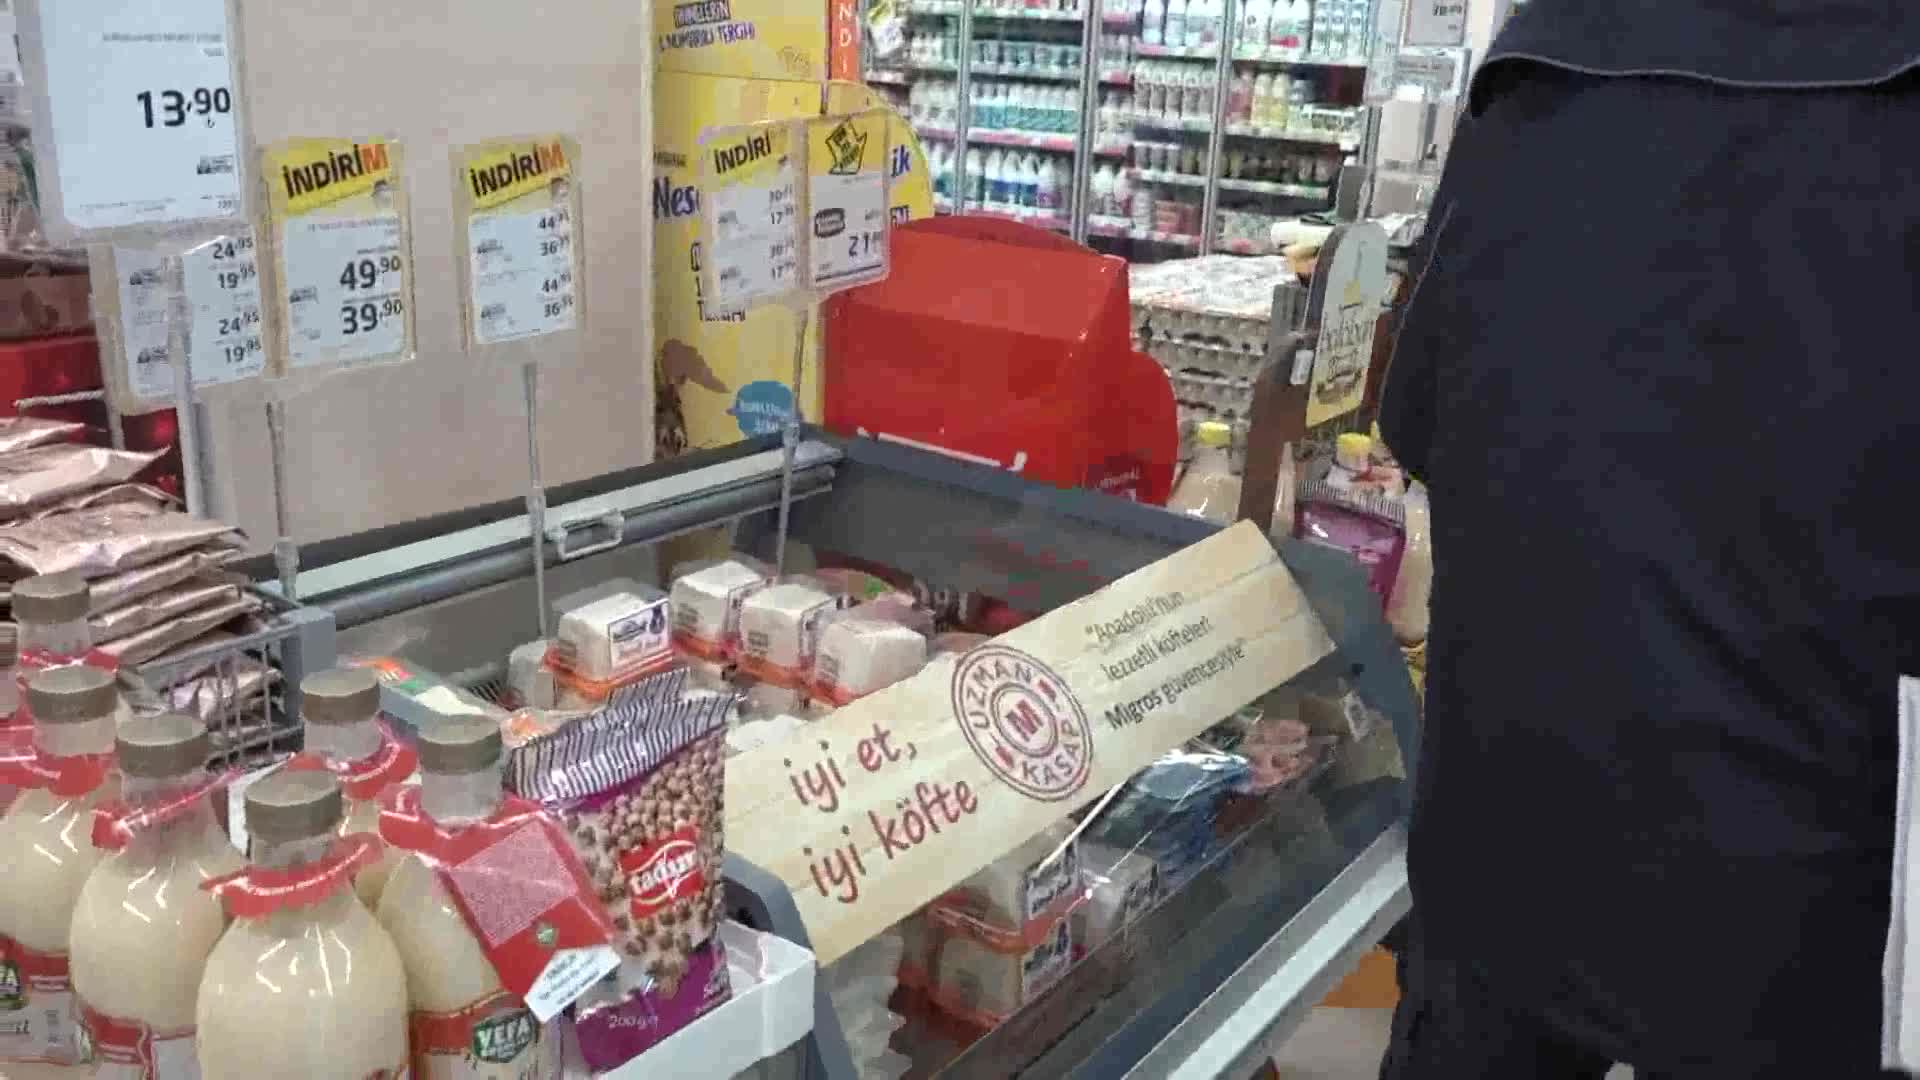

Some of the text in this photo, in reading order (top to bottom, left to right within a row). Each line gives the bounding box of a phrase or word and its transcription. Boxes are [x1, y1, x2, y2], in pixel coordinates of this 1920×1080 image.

[137, 87, 231, 128] 13,90
[339, 255, 401, 290] 49,90
[341, 299, 402, 335] 39,90
[966, 660, 1033, 730] UZMAN
[1104, 689, 1162, 731] Migros
[1006, 698, 1044, 742] M
[784, 723, 917, 813] iyi et,
[1022, 719, 1081, 786] KASAP
[803, 780, 978, 904] iyi köfte
